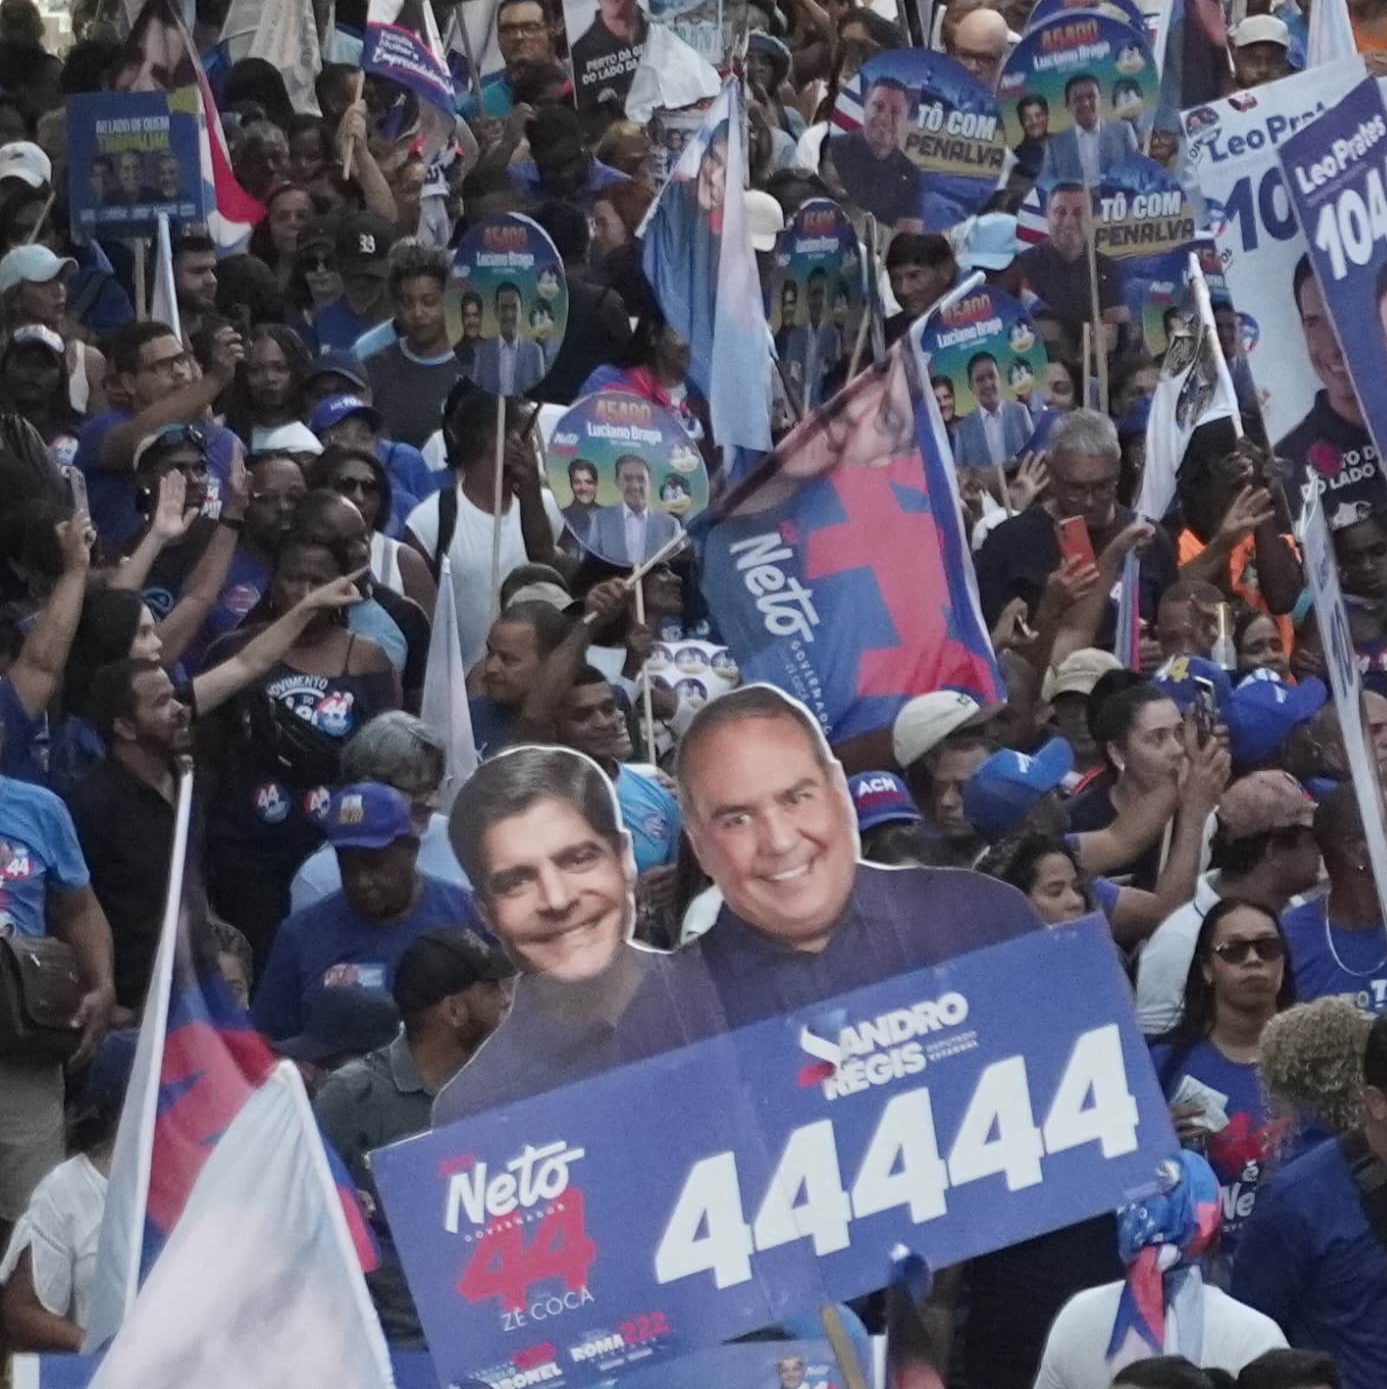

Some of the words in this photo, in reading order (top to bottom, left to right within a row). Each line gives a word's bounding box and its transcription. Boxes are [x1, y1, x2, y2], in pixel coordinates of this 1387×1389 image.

[947, 110, 997, 141] COM
[1100, 196, 1128, 223] TÔ
[1130, 191, 1182, 217] COM
[1094, 216, 1196, 249] PENALVA
[587, 422, 630, 440] Luciano
[1330, 464, 1376, 490] LADO
[729, 531, 821, 643] Neto
[856, 776, 898, 795] ACM
[823, 1041, 928, 1101] RÉGIS
[654, 1023, 1140, 1291] 44444
[445, 1140, 585, 1234] Neto
[456, 1187, 597, 1314] 44
[570, 1333, 625, 1362] ROMA
